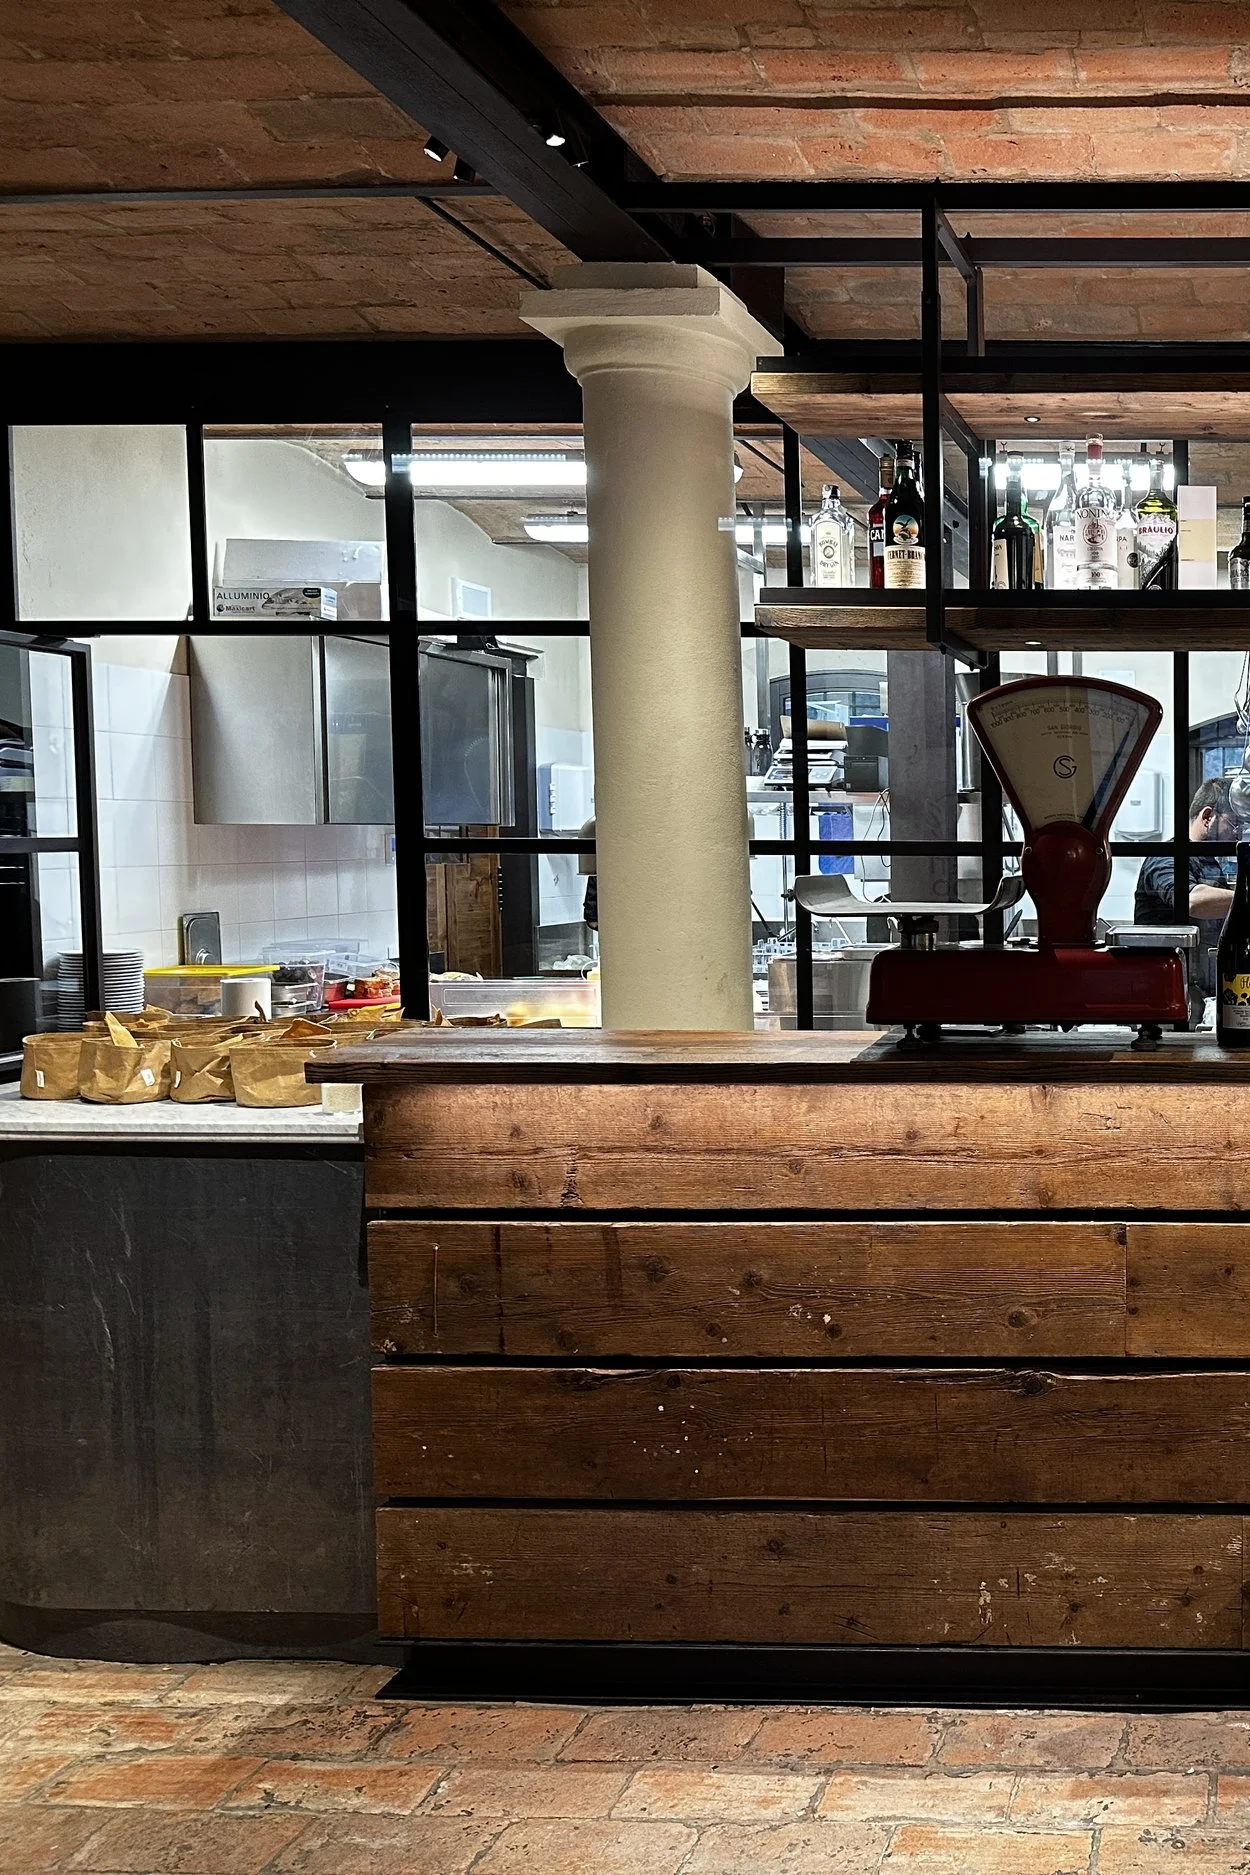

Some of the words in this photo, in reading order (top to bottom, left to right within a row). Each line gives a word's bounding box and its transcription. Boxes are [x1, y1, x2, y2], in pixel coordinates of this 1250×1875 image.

[1138, 526, 1174, 535] BRAULIO
[1060, 534, 1075, 542] NAR
[216, 592, 270, 600] ALLUMINIO
